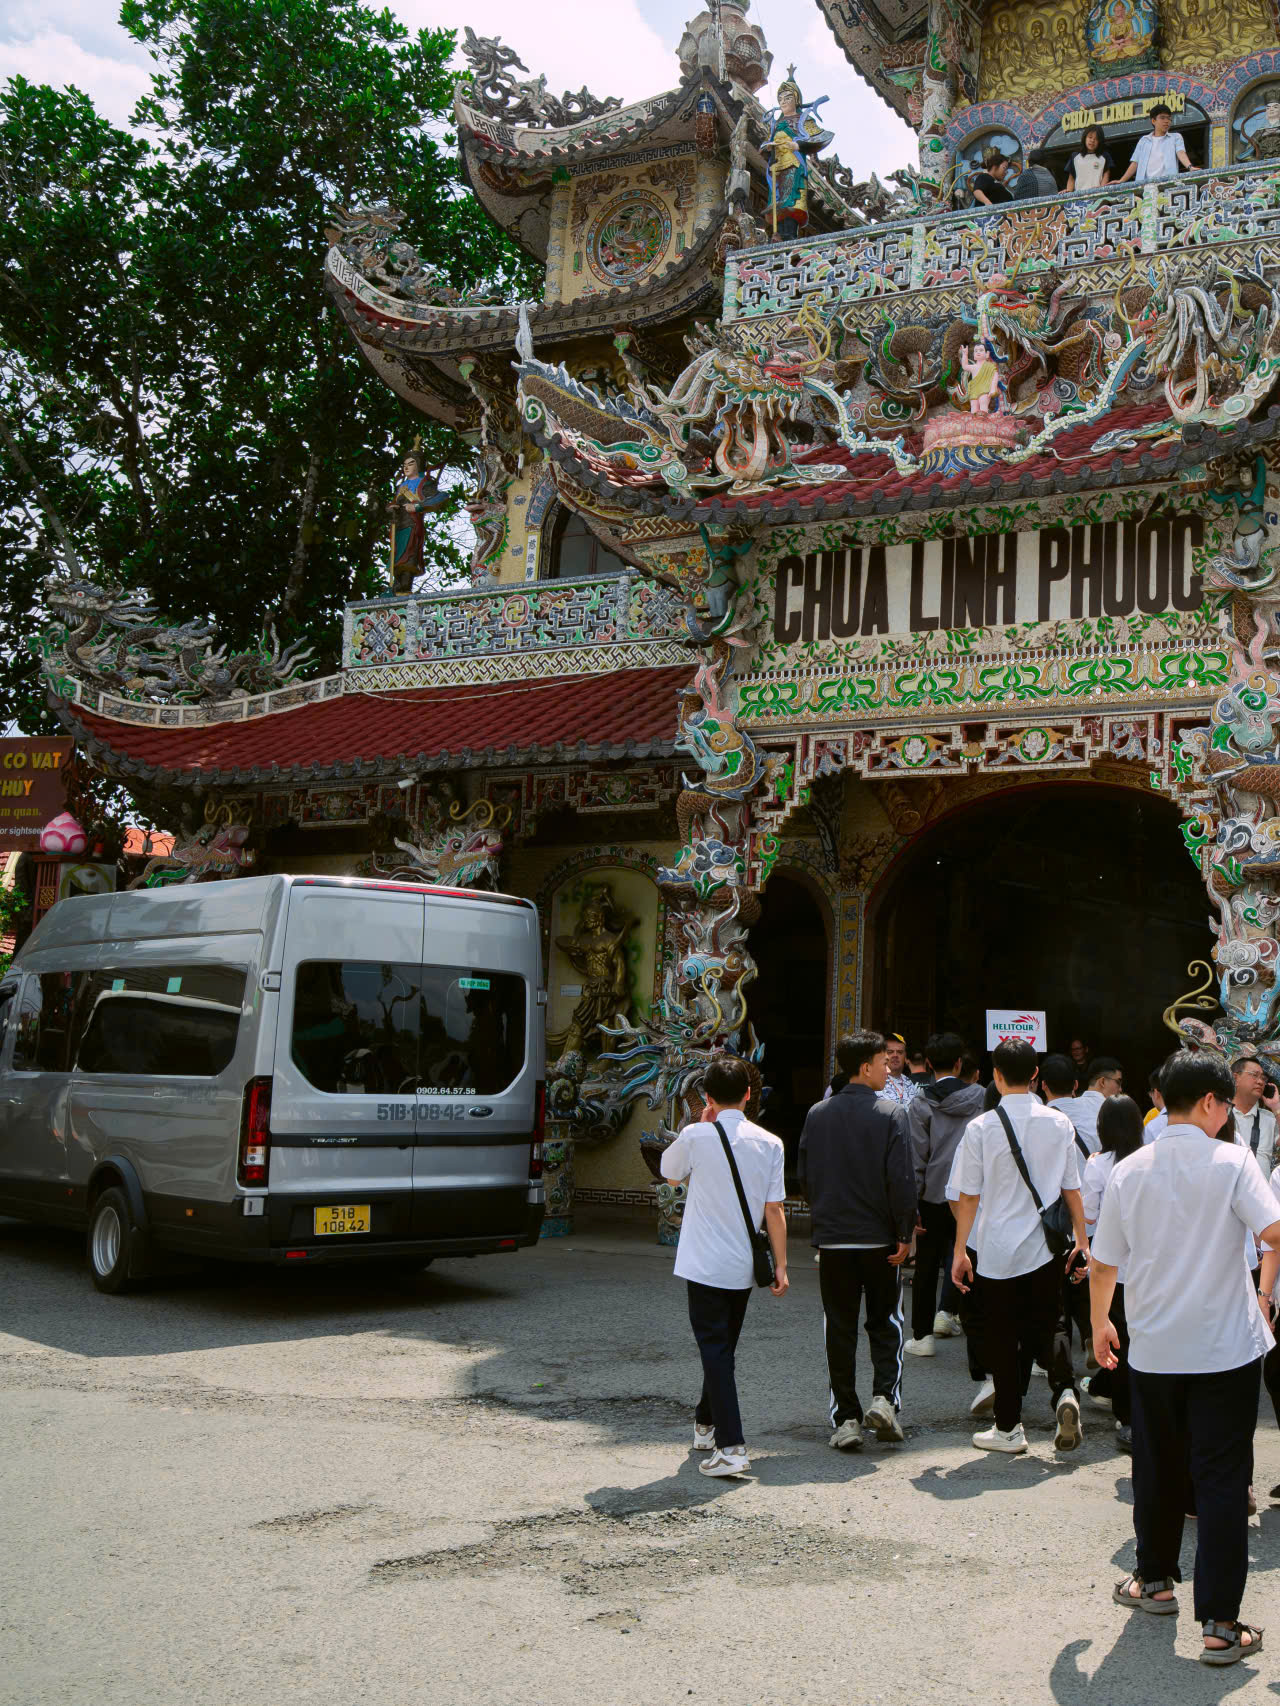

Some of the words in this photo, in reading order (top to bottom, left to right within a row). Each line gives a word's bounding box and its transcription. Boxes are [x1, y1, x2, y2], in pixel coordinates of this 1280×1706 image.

[1062, 106, 1096, 131] CHÙA
[1103, 103, 1133, 123] LINH
[773, 533, 889, 644] CHÙA
[909, 524, 1018, 632] LINH
[1037, 493, 1204, 623] PHƯỚC
[416, 1087, 476, 1095] 0902.64.57.58
[331, 1207, 355, 1220] 51B
[323, 1220, 365, 1233] 108.42
